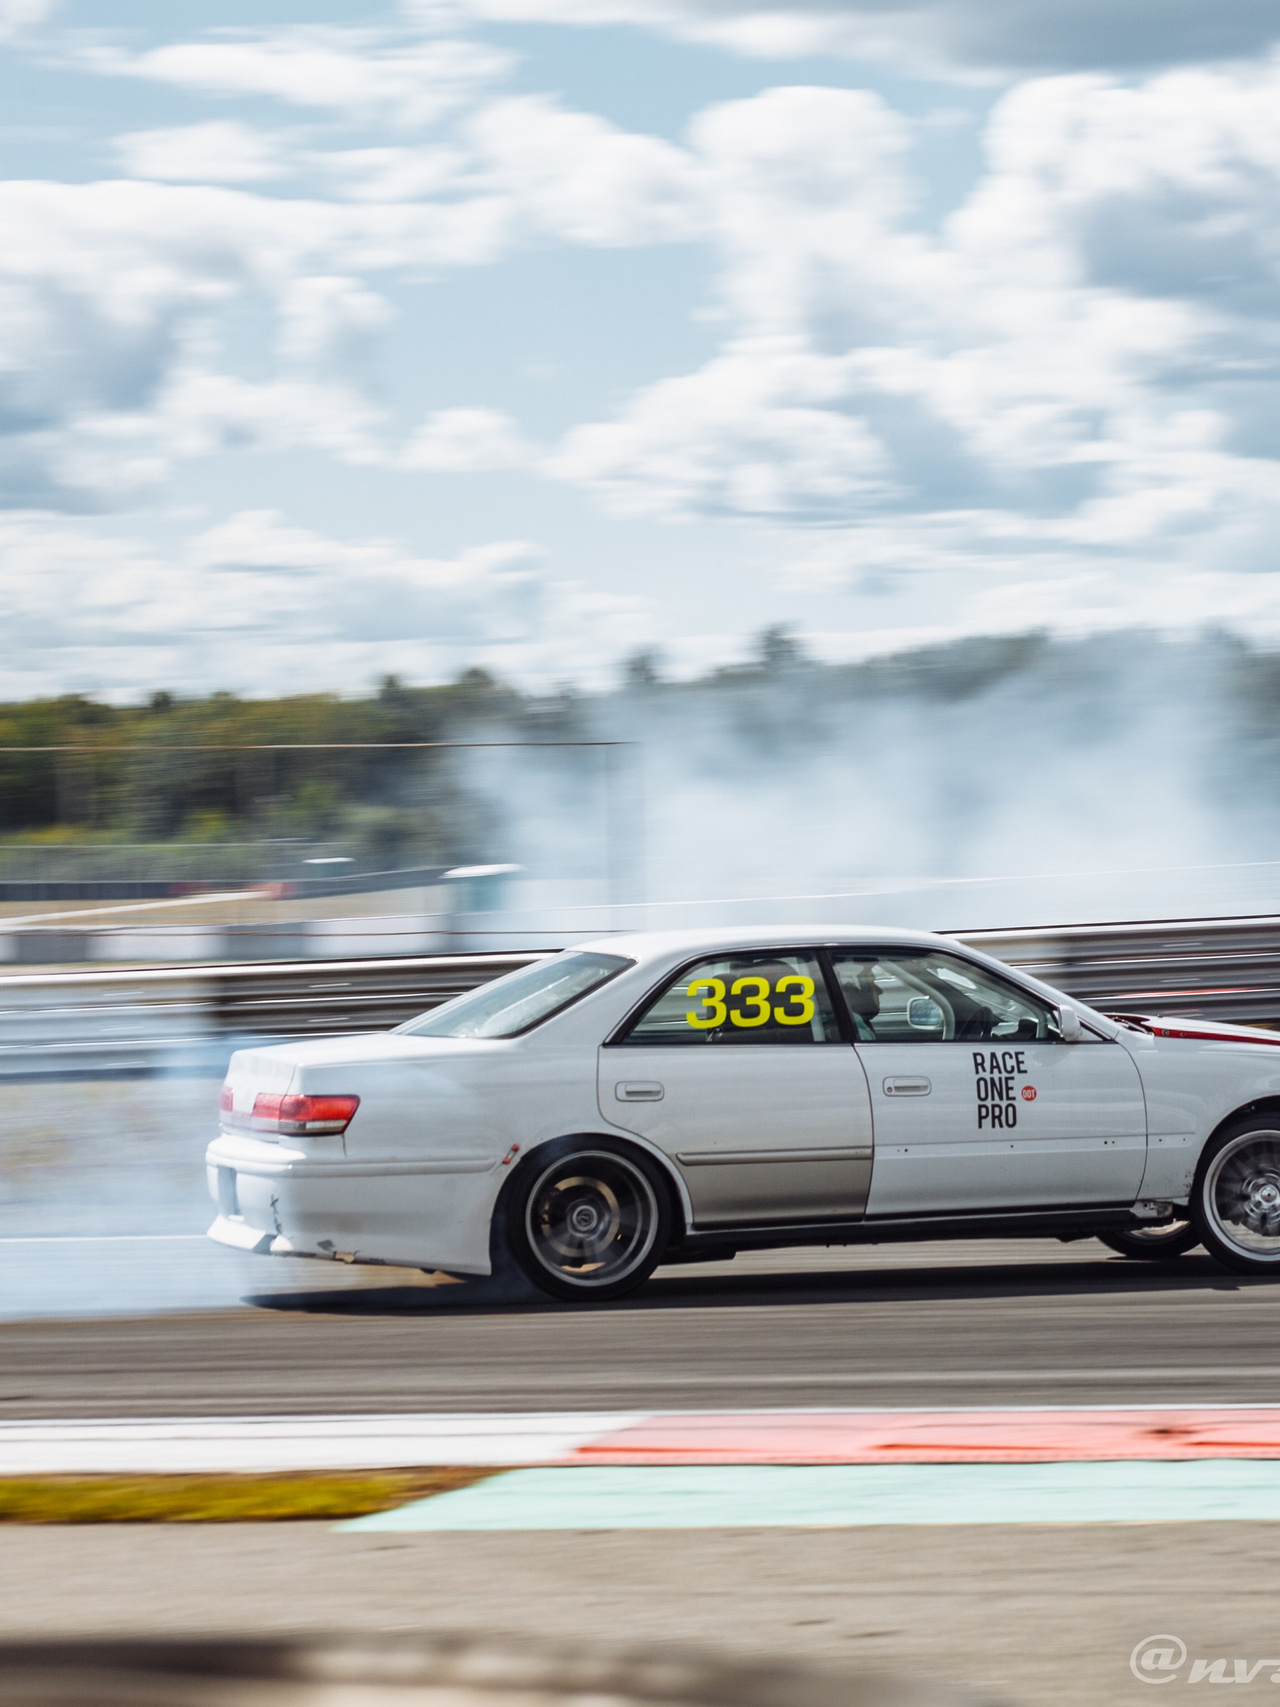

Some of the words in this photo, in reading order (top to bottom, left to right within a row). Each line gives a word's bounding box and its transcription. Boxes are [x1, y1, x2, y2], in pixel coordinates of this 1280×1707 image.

[686, 975, 815, 1029] 333
[972, 1051, 1028, 1075] RACE
[976, 1076, 1016, 1102] ONE
[977, 1103, 1017, 1129] PRO
